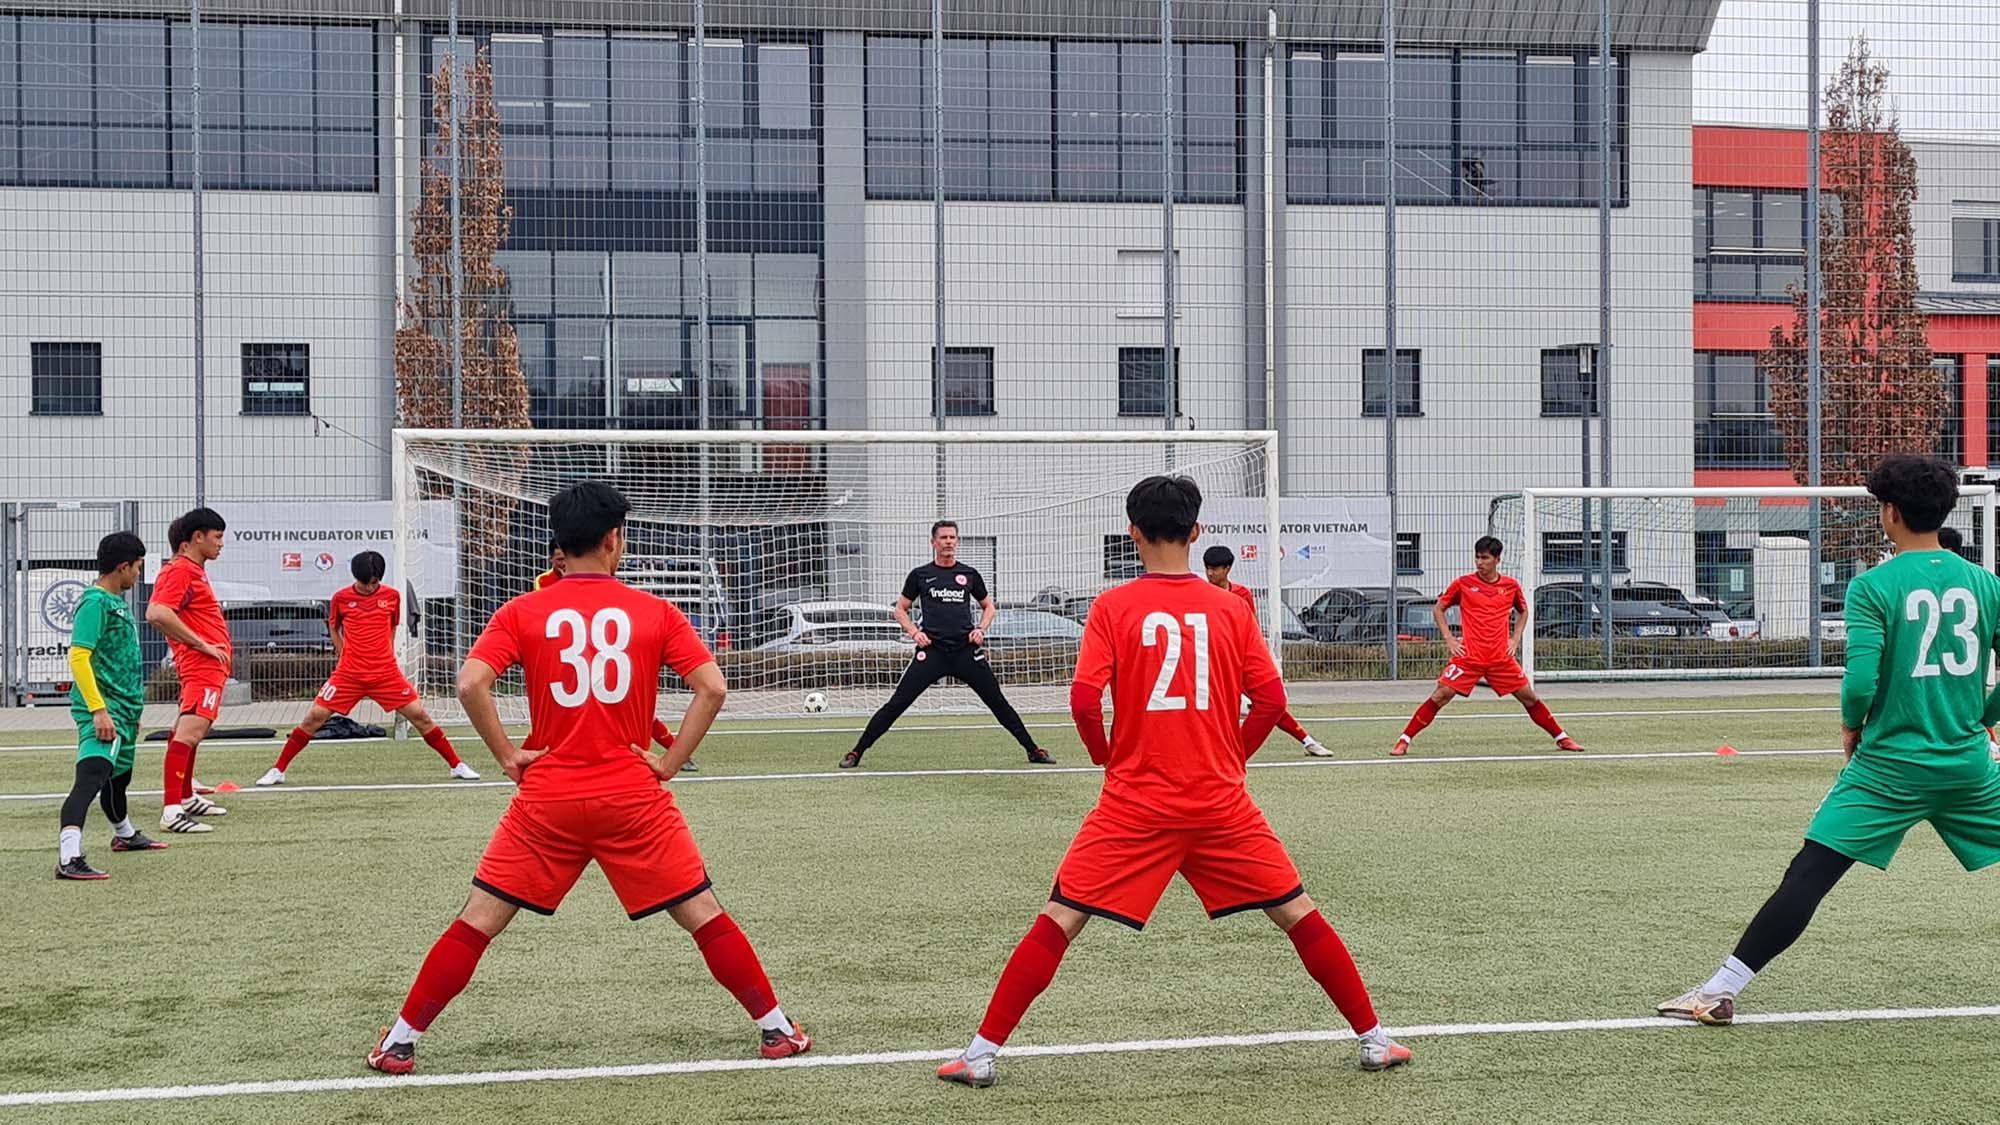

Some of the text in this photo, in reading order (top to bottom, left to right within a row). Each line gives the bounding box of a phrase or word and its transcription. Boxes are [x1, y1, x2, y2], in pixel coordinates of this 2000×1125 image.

[233, 529, 428, 541] YOUTH INCUBATOR VIETAM
[1200, 523, 1368, 534] YOUTH INCATOR VIETNAM
[929, 587, 965, 598] indeed
[1906, 587, 1979, 678] 23
[545, 607, 632, 708] 38
[1142, 611, 1210, 711] 21
[1444, 663, 1464, 681] 37
[202, 687, 217, 711] 14
